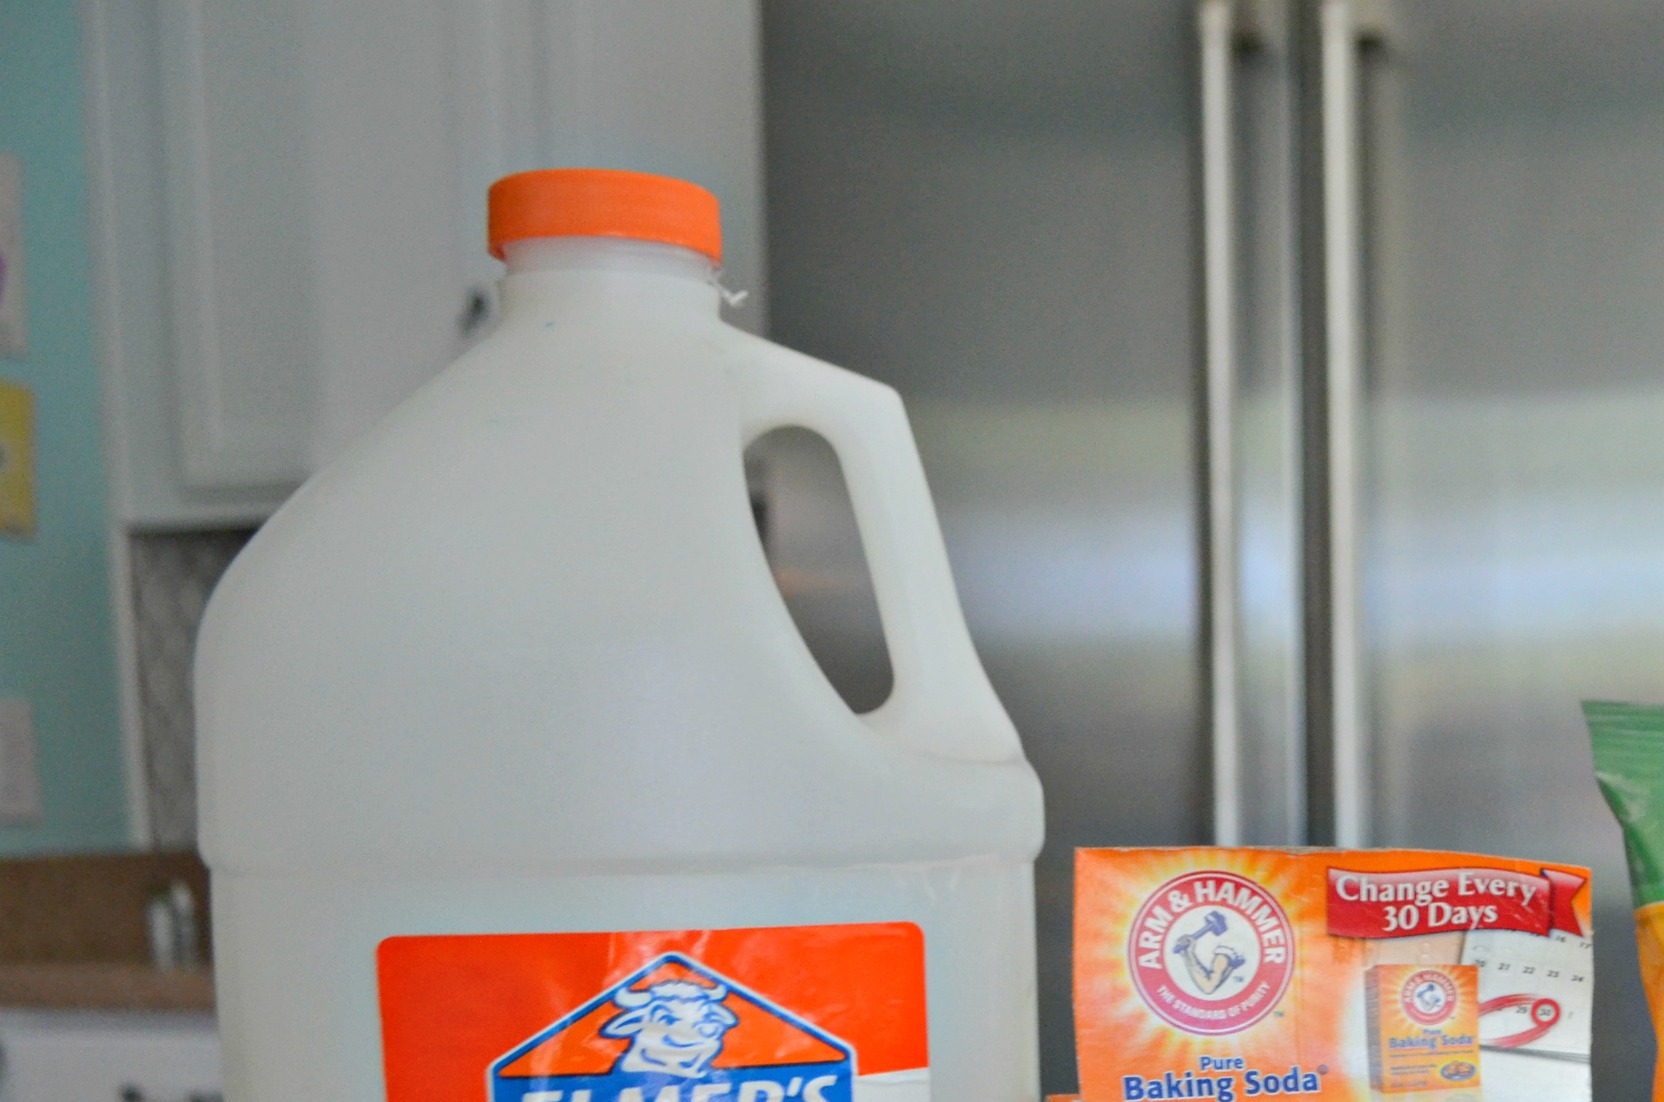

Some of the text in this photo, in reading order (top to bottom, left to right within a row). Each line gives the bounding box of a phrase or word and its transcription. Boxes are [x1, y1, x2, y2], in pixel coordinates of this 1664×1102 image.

[1335, 871, 1537, 910] Change Every
[1138, 879, 1287, 970] ARM & HAMMER
[1382, 900, 1499, 932] 30 Days
[1199, 1055, 1245, 1072] Pure
[1243, 1066, 1320, 1096] Soda
